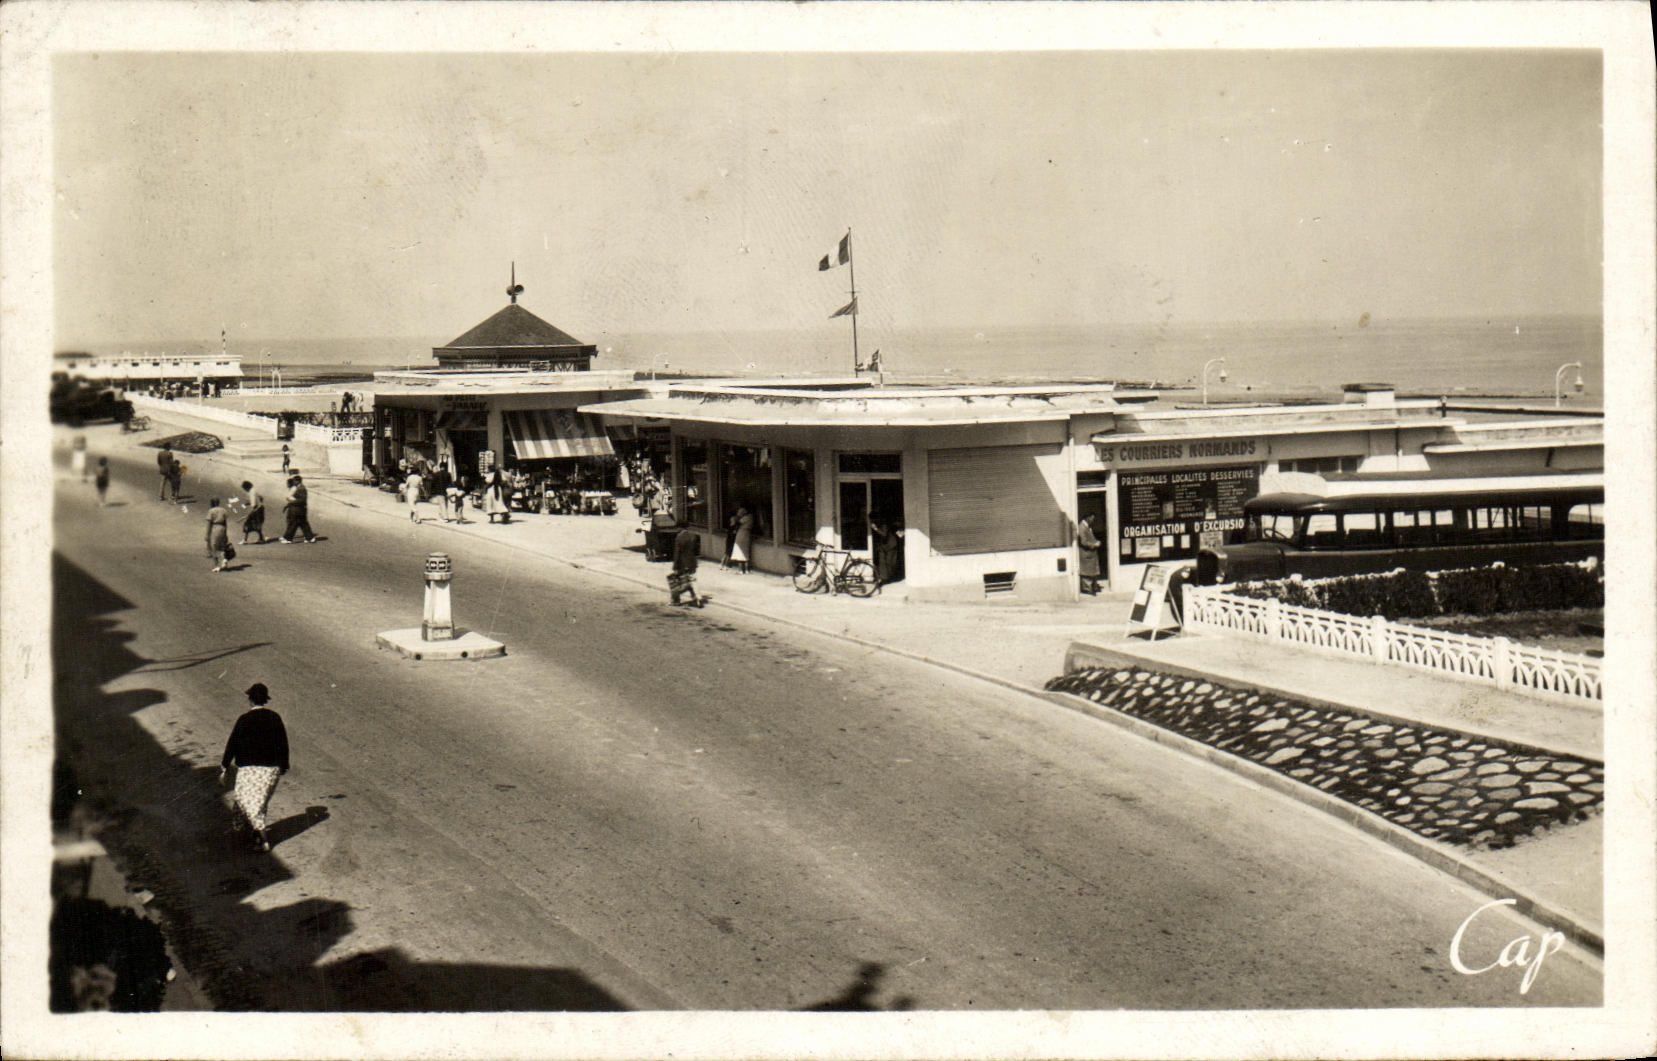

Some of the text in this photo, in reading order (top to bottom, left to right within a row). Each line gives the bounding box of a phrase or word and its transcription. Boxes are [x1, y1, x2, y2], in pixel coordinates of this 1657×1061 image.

[1120, 444, 1183, 461] COURRIERS
[1189, 440, 1256, 458] NORMANDS
[1121, 474, 1167, 486] PRINCIPALES
[1210, 469, 1254, 481] DESSERVIES
[1124, 523, 1185, 538] ORGANISATION
